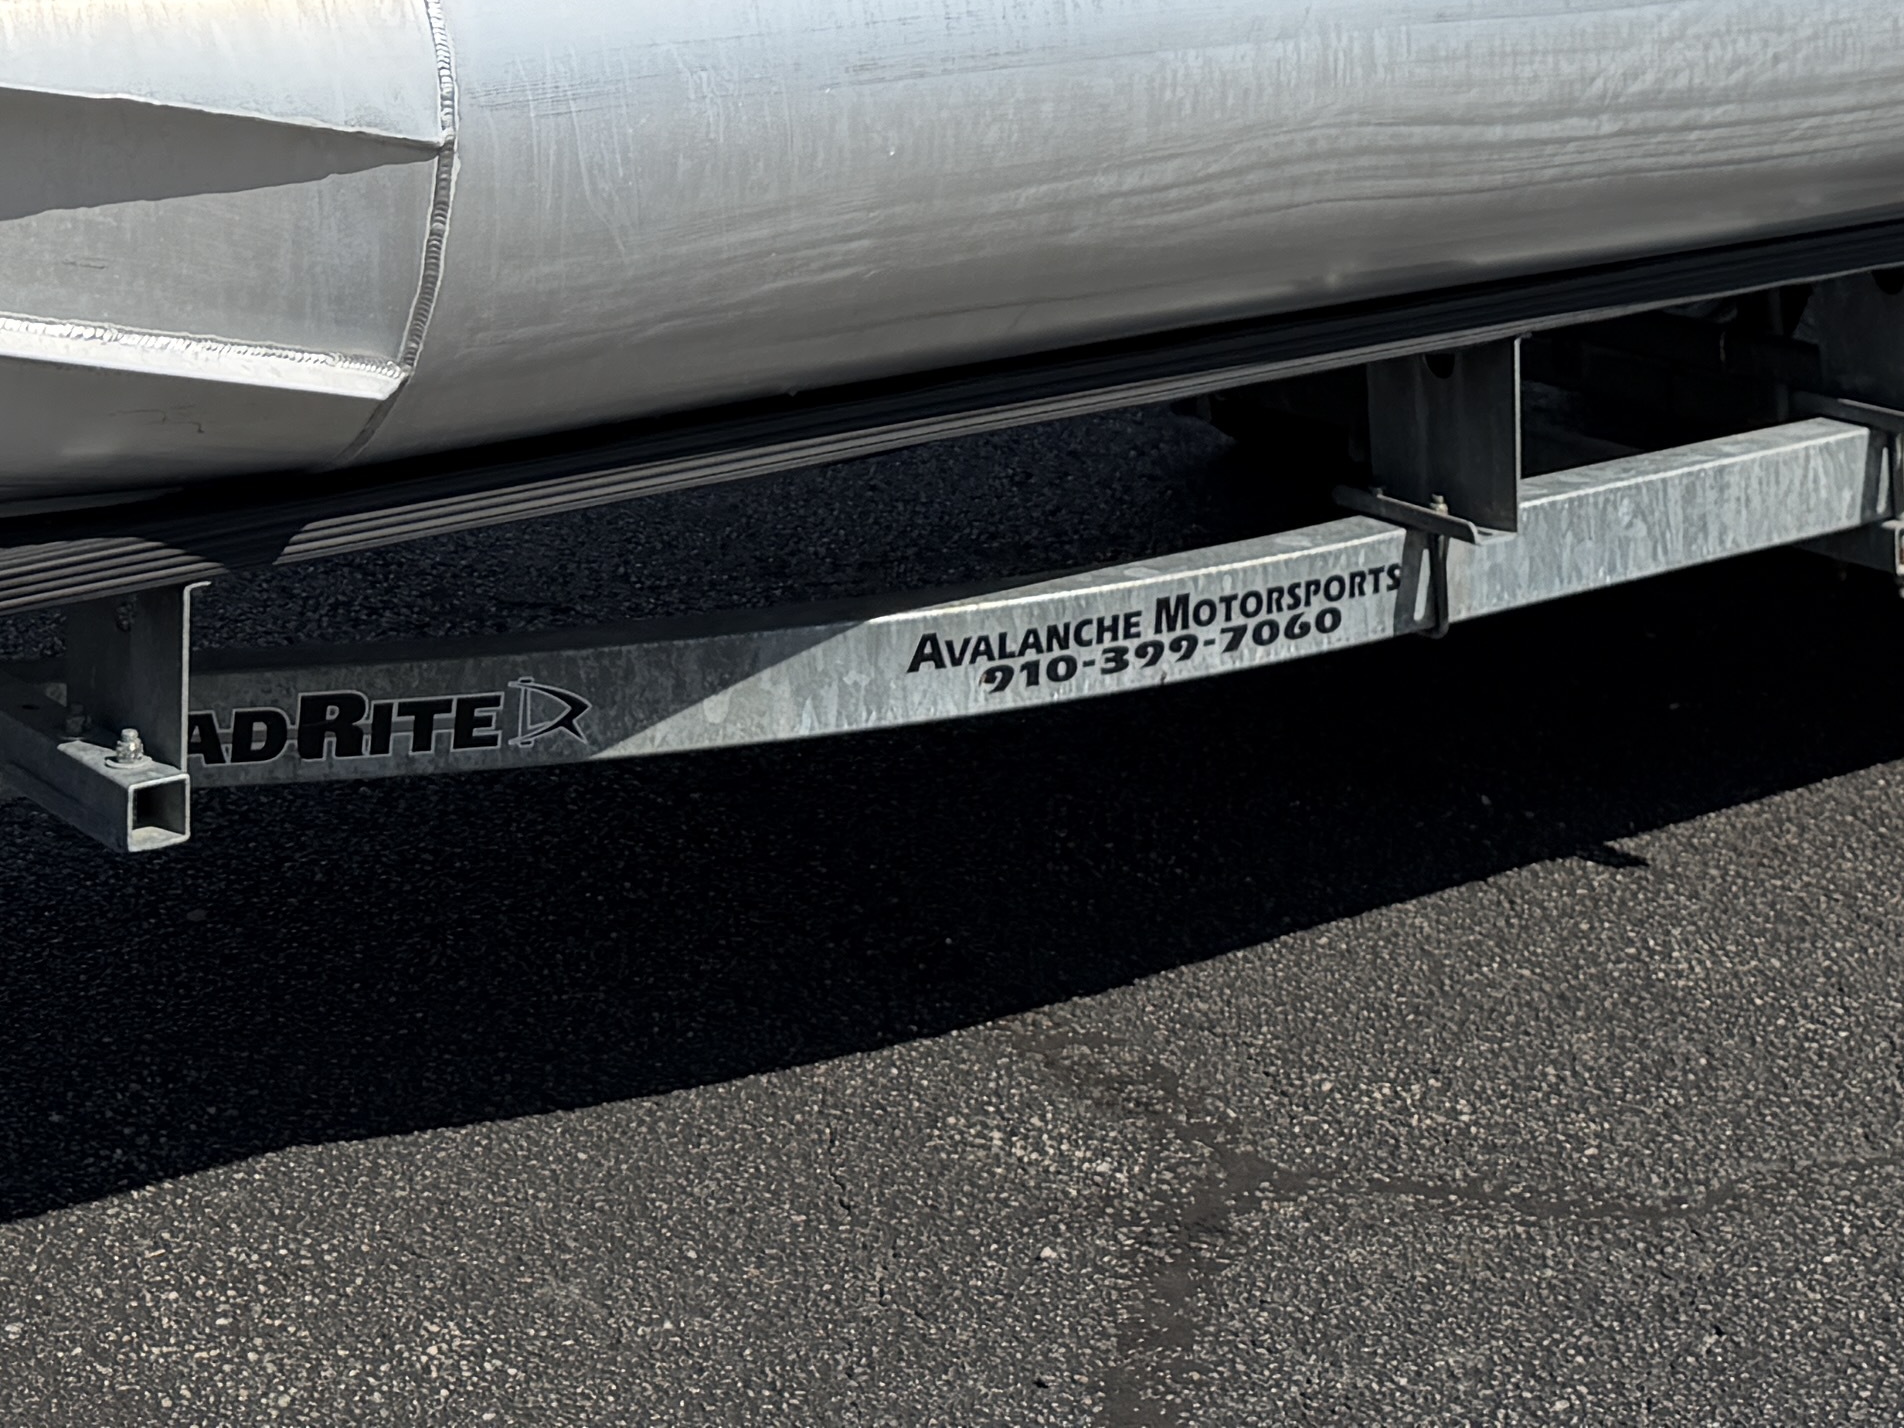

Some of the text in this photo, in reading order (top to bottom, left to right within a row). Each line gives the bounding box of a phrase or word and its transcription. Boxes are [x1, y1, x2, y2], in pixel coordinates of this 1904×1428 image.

[907, 563, 1402, 674] AVALANCHE MOTORSPORTS
[979, 607, 1343, 694] 910-399-7060
